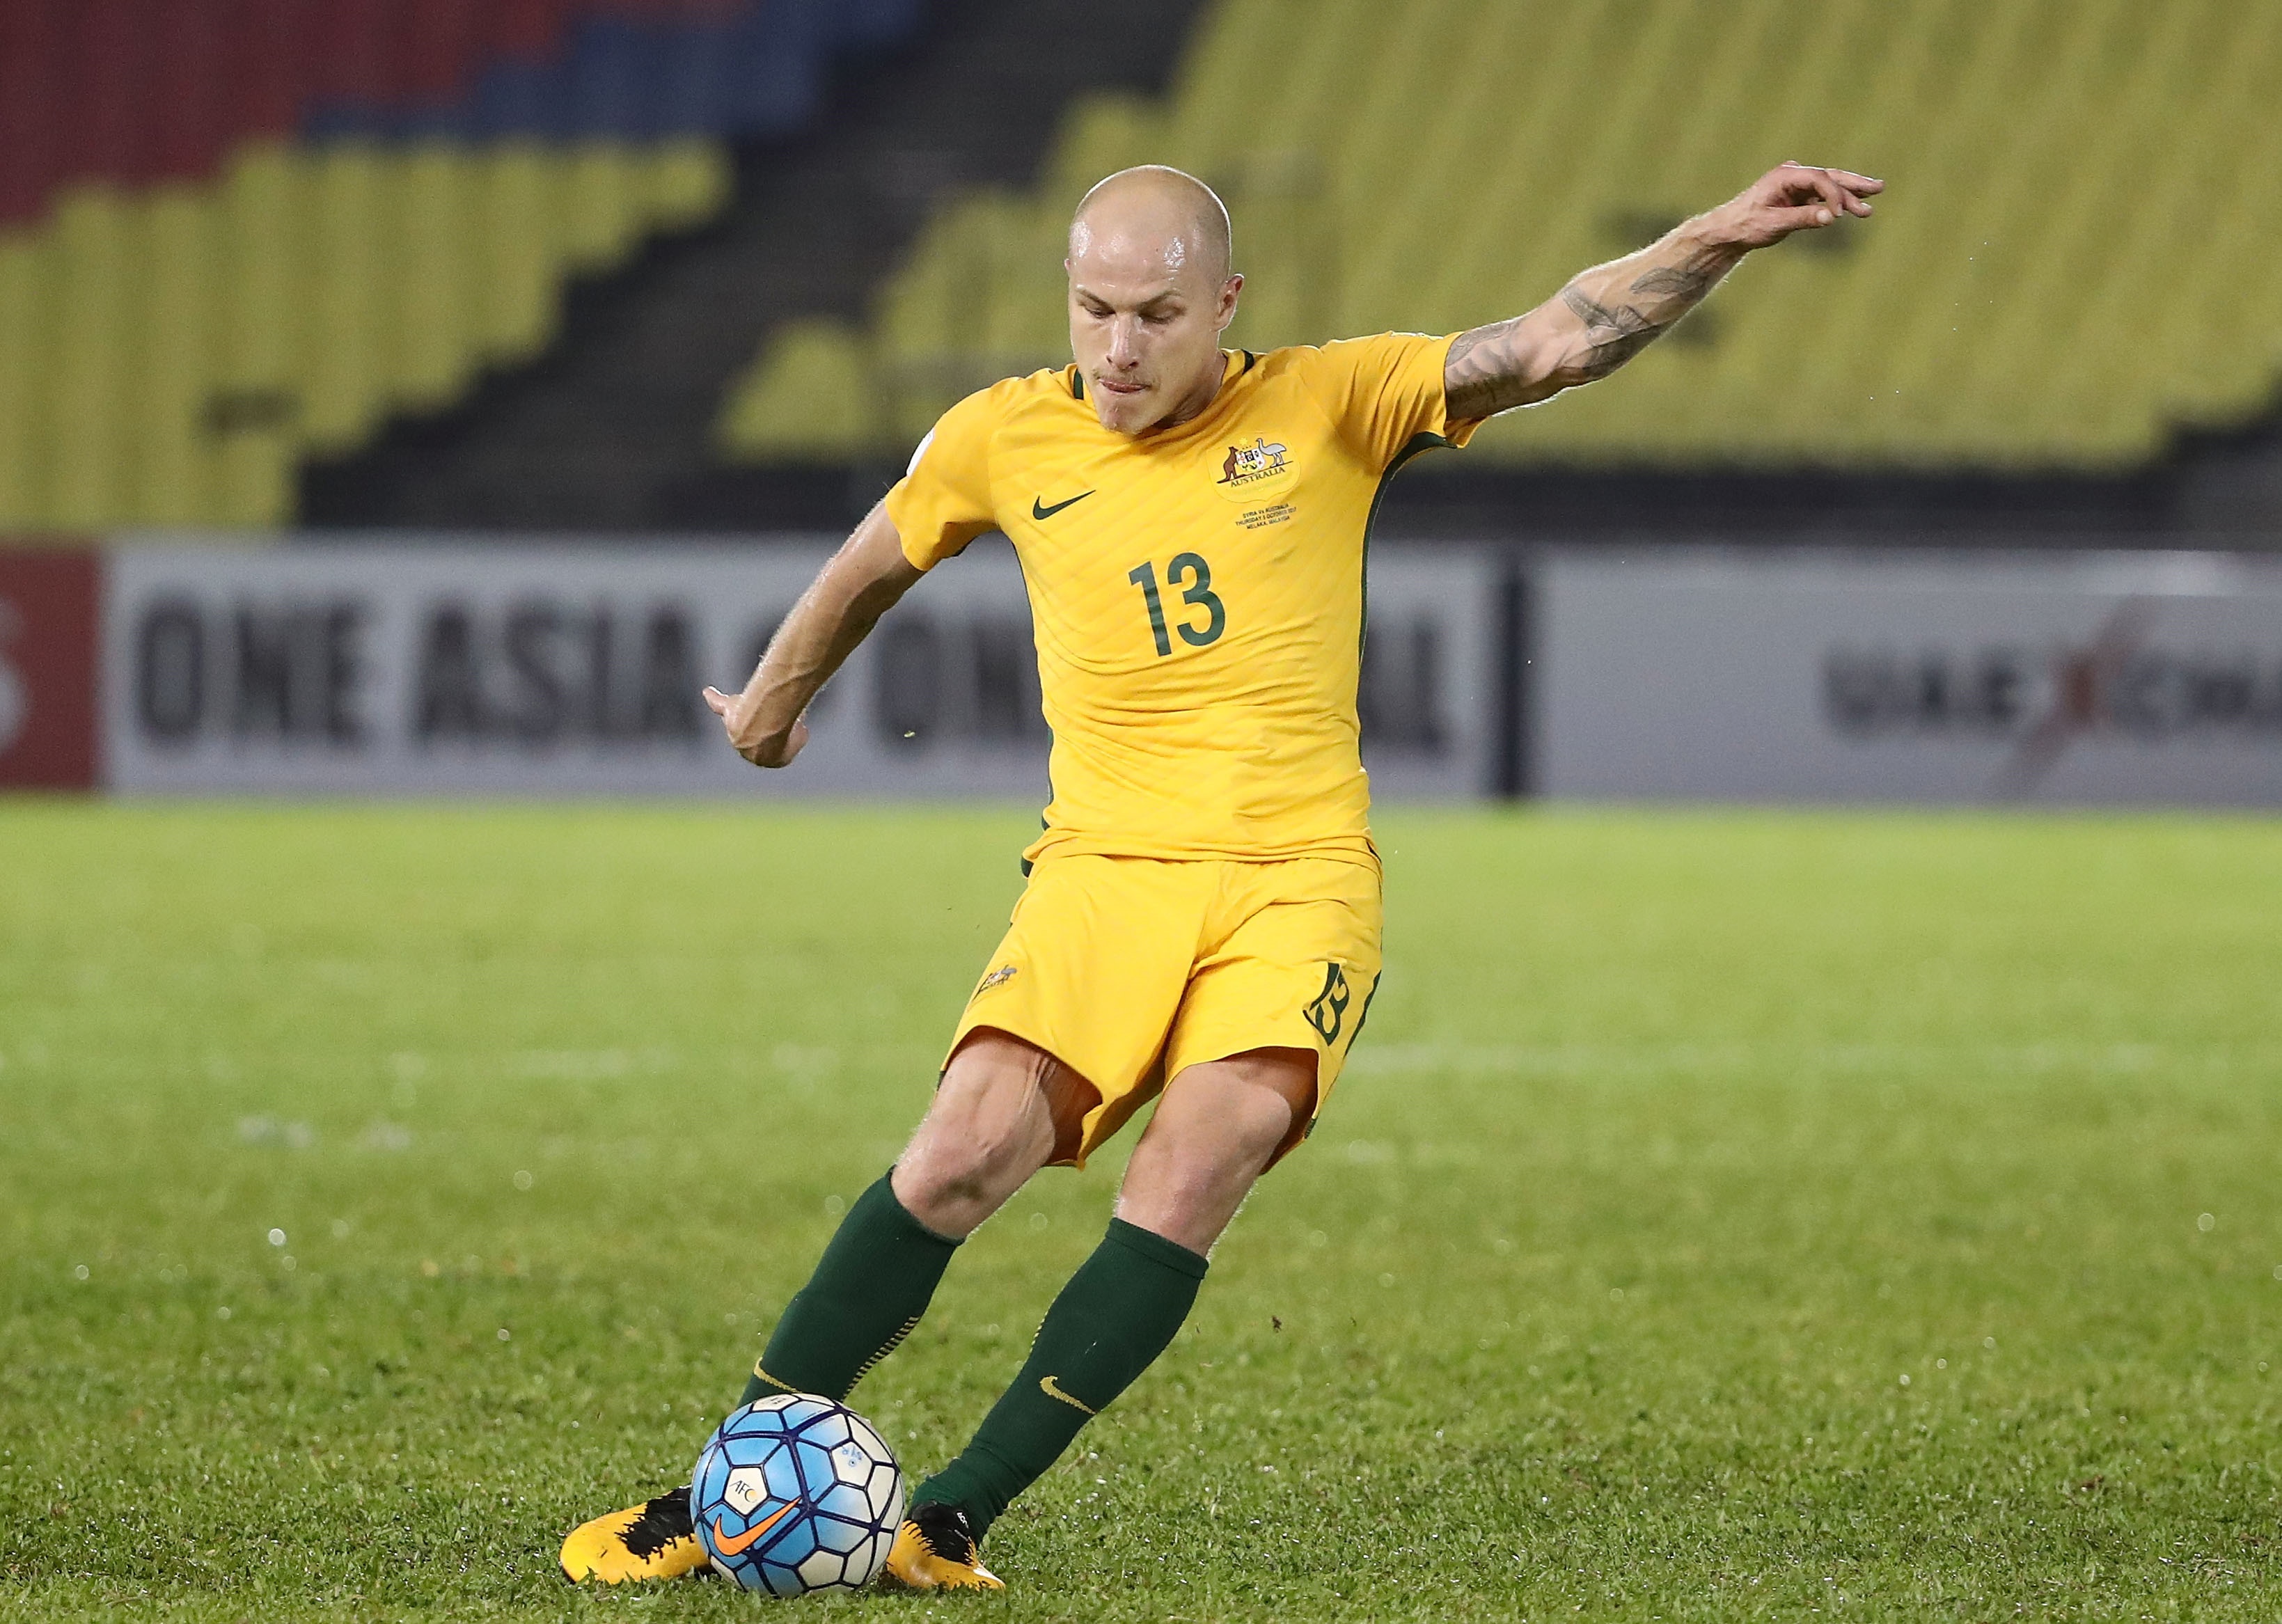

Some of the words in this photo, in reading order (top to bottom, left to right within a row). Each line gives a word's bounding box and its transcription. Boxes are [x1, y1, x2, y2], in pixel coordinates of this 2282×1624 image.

[1231, 466, 1286, 487] AUSTRALIA
[1266, 503, 1289, 512] AUSTRALIA
[1236, 516, 1262, 526] THURSDAY
[1128, 552, 1225, 656] 13
[134, 599, 372, 752] ONE
[416, 599, 700, 752] ASIA
[873, 604, 1044, 755] ON
[729, 1480, 757, 1503] AFC
